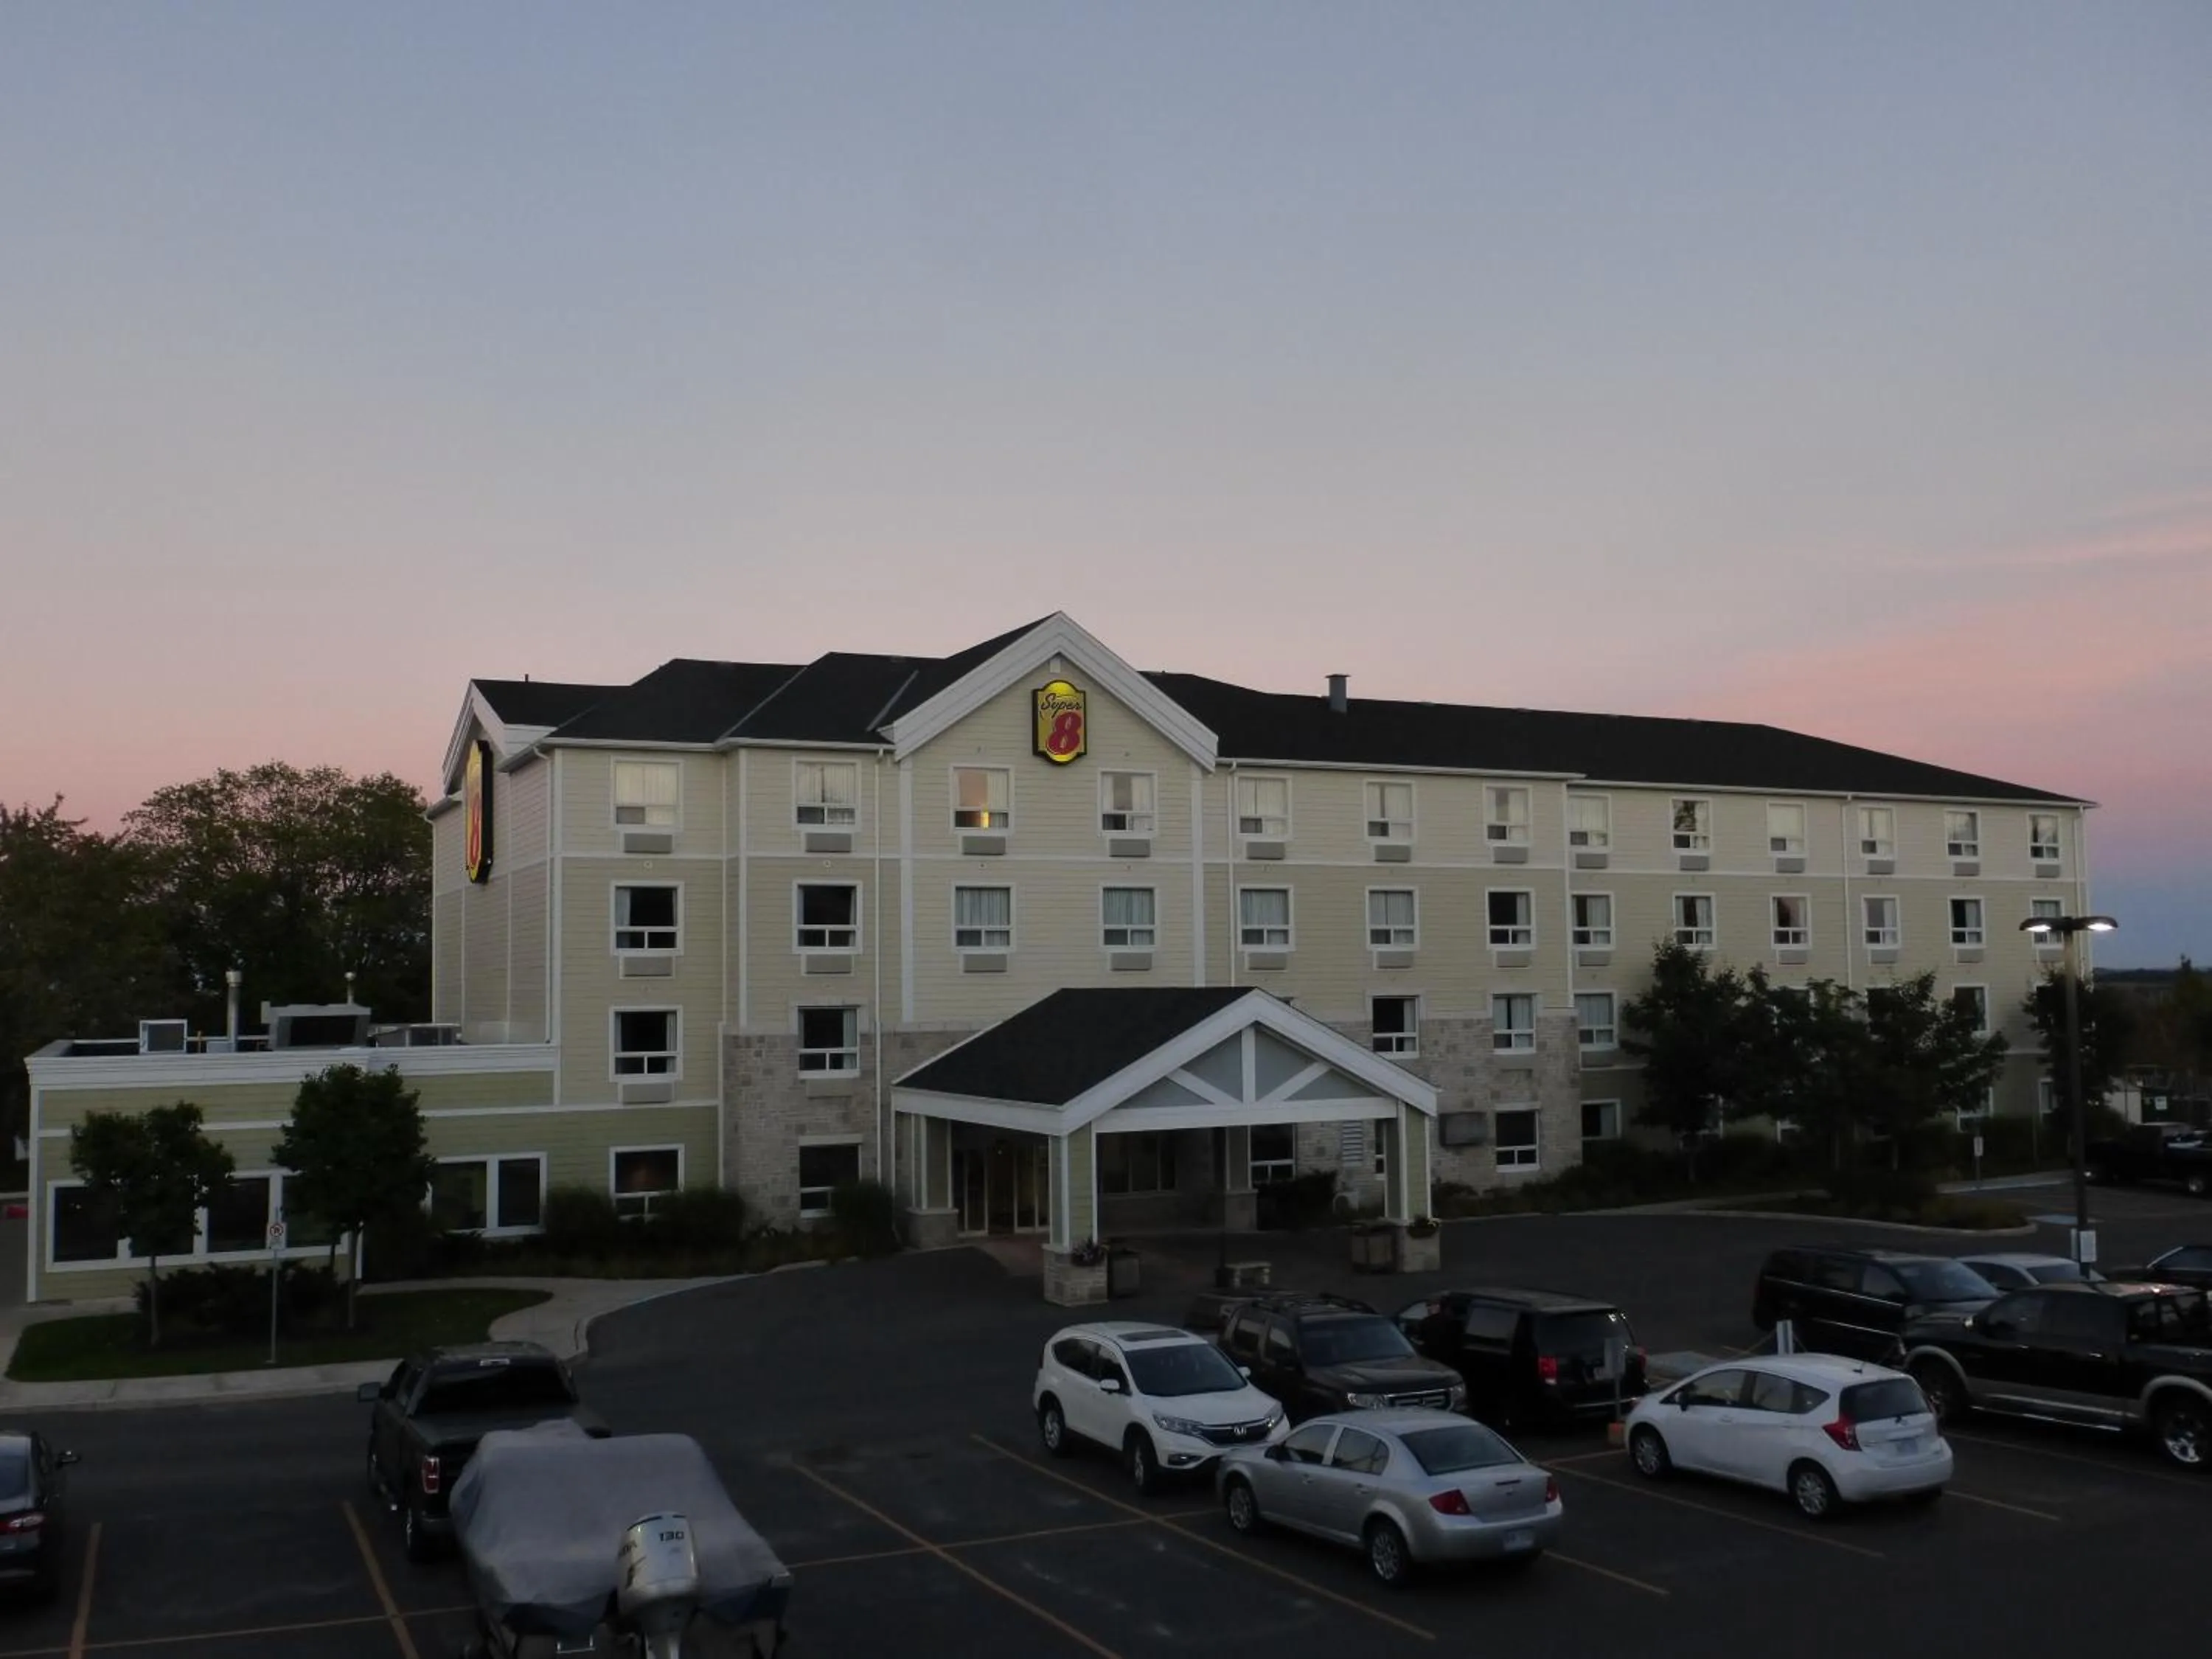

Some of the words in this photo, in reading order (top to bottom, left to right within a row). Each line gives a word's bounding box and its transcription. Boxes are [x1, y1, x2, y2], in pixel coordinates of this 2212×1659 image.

[1040, 692, 1082, 718] Super
[1046, 712, 1082, 754] 8
[659, 1531, 684, 1541] 130
